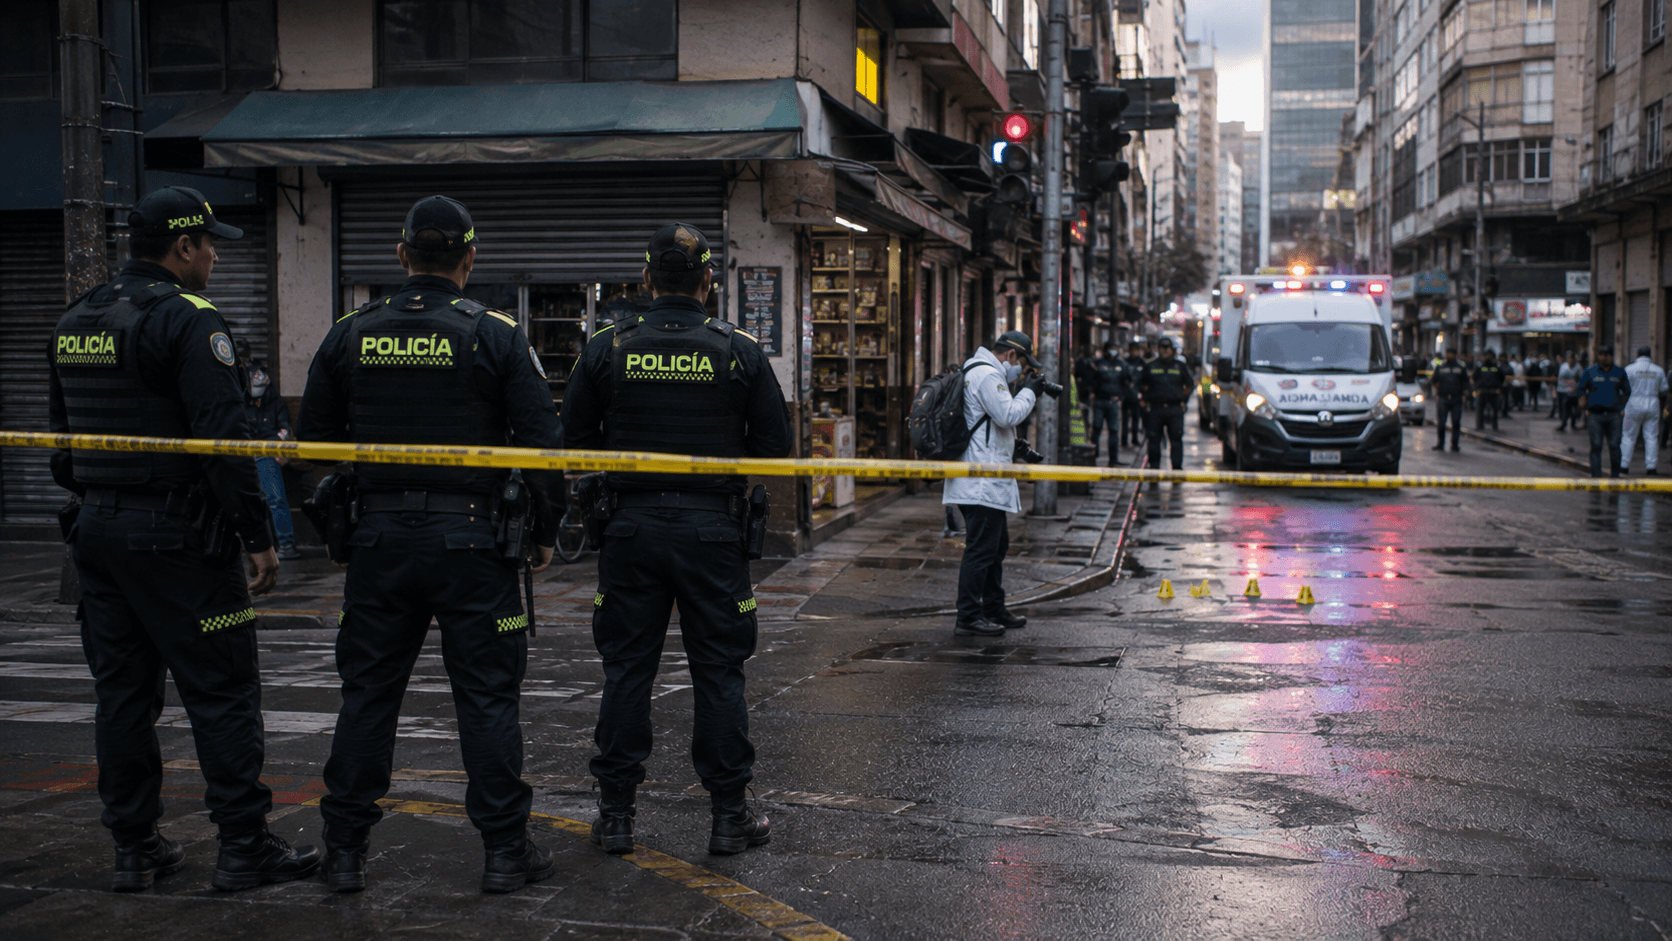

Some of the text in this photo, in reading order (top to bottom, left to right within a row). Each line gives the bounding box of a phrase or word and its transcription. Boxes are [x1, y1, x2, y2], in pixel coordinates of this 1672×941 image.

[56, 330, 115, 354] POLICÍA
[361, 333, 453, 356] POLICÍA
[626, 351, 714, 373] POLICÍA
